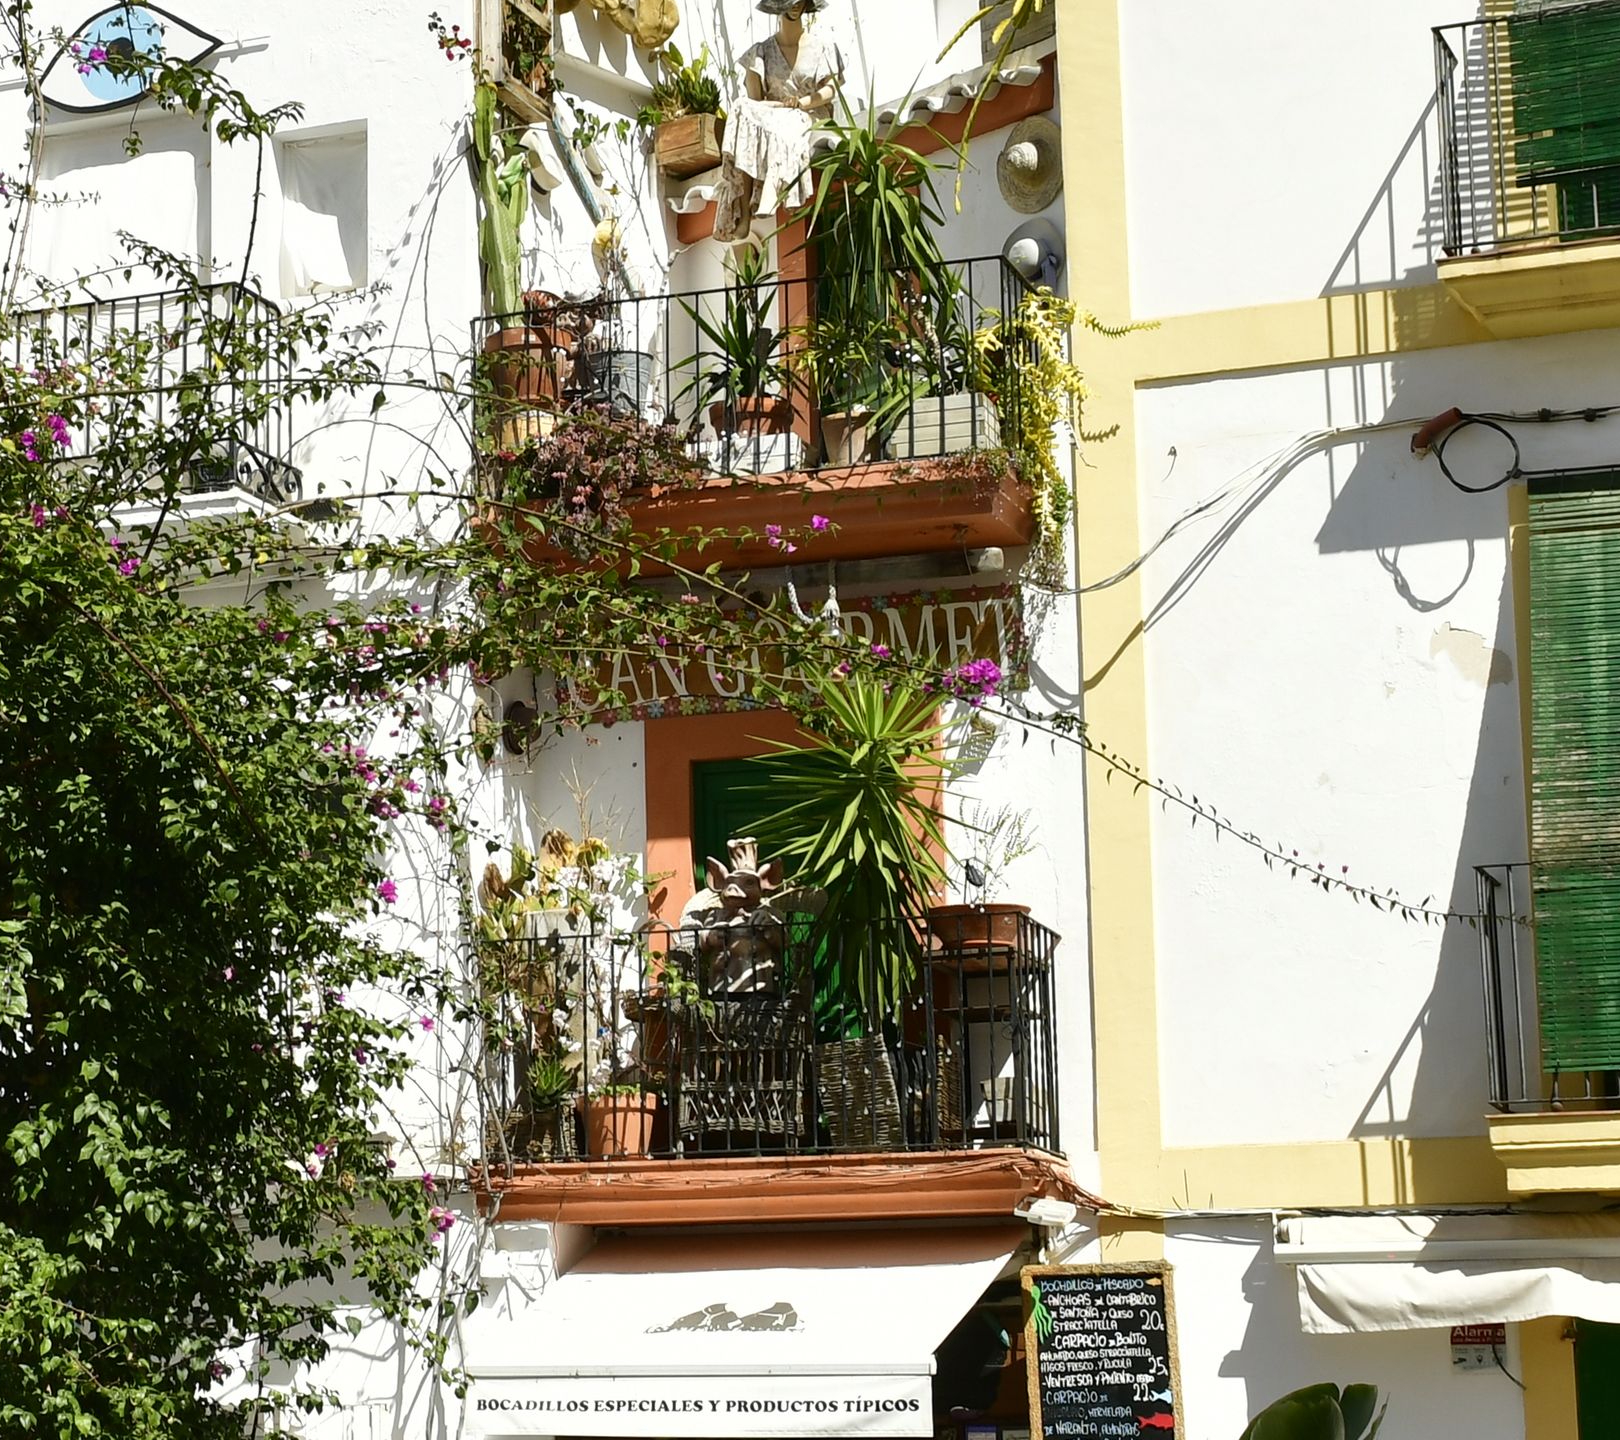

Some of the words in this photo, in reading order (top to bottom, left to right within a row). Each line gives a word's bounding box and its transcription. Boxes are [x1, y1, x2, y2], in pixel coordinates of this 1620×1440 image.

[1108, 1309, 1134, 1319] QUESO
[477, 1399, 589, 1412] BOCADILLOS
[594, 1399, 703, 1413] ESPECIALES
[708, 1400, 720, 1412] Y
[726, 1400, 839, 1413] PRODUCTOS
[843, 1396, 920, 1413] TÍPICOS
